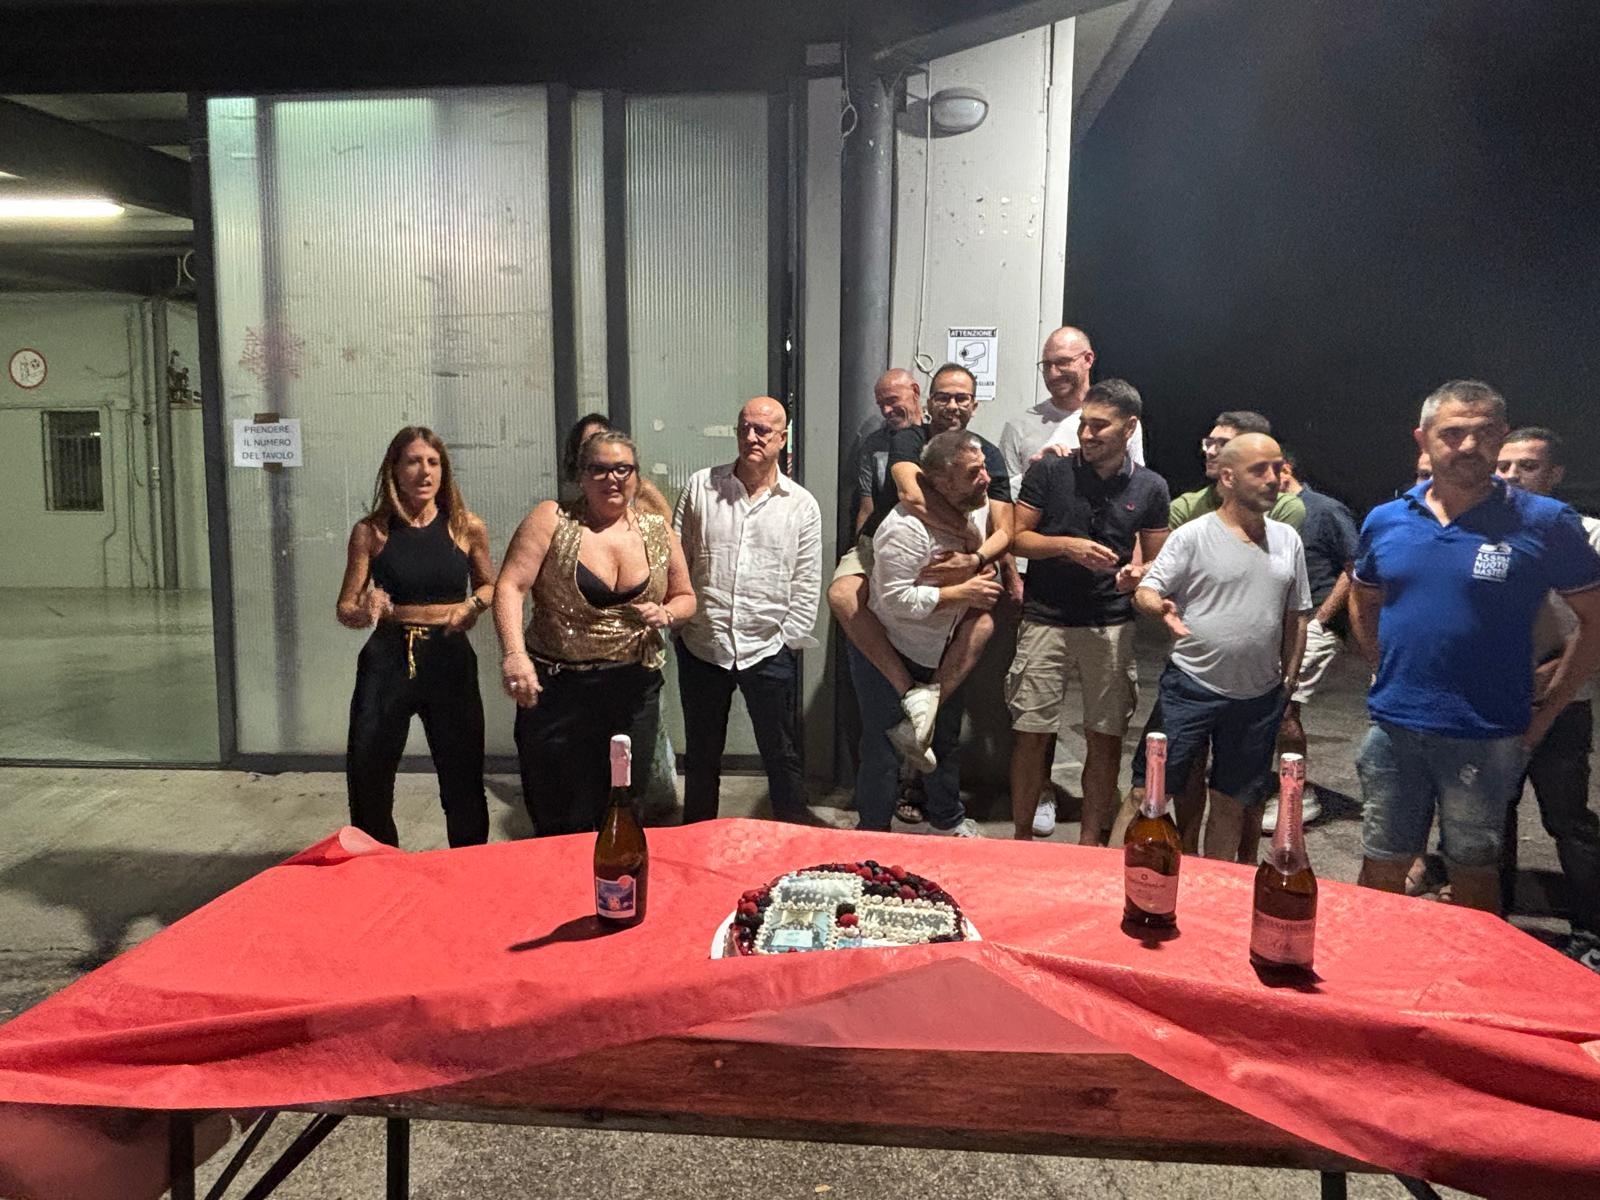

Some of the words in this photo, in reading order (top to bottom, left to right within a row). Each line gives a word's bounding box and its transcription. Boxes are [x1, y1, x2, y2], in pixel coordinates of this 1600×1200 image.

[244, 425, 289, 433] PRENDERE
[254, 438, 291, 446] NUMERO
[242, 451, 261, 459] DEL
[262, 451, 294, 459] TAVOLO
